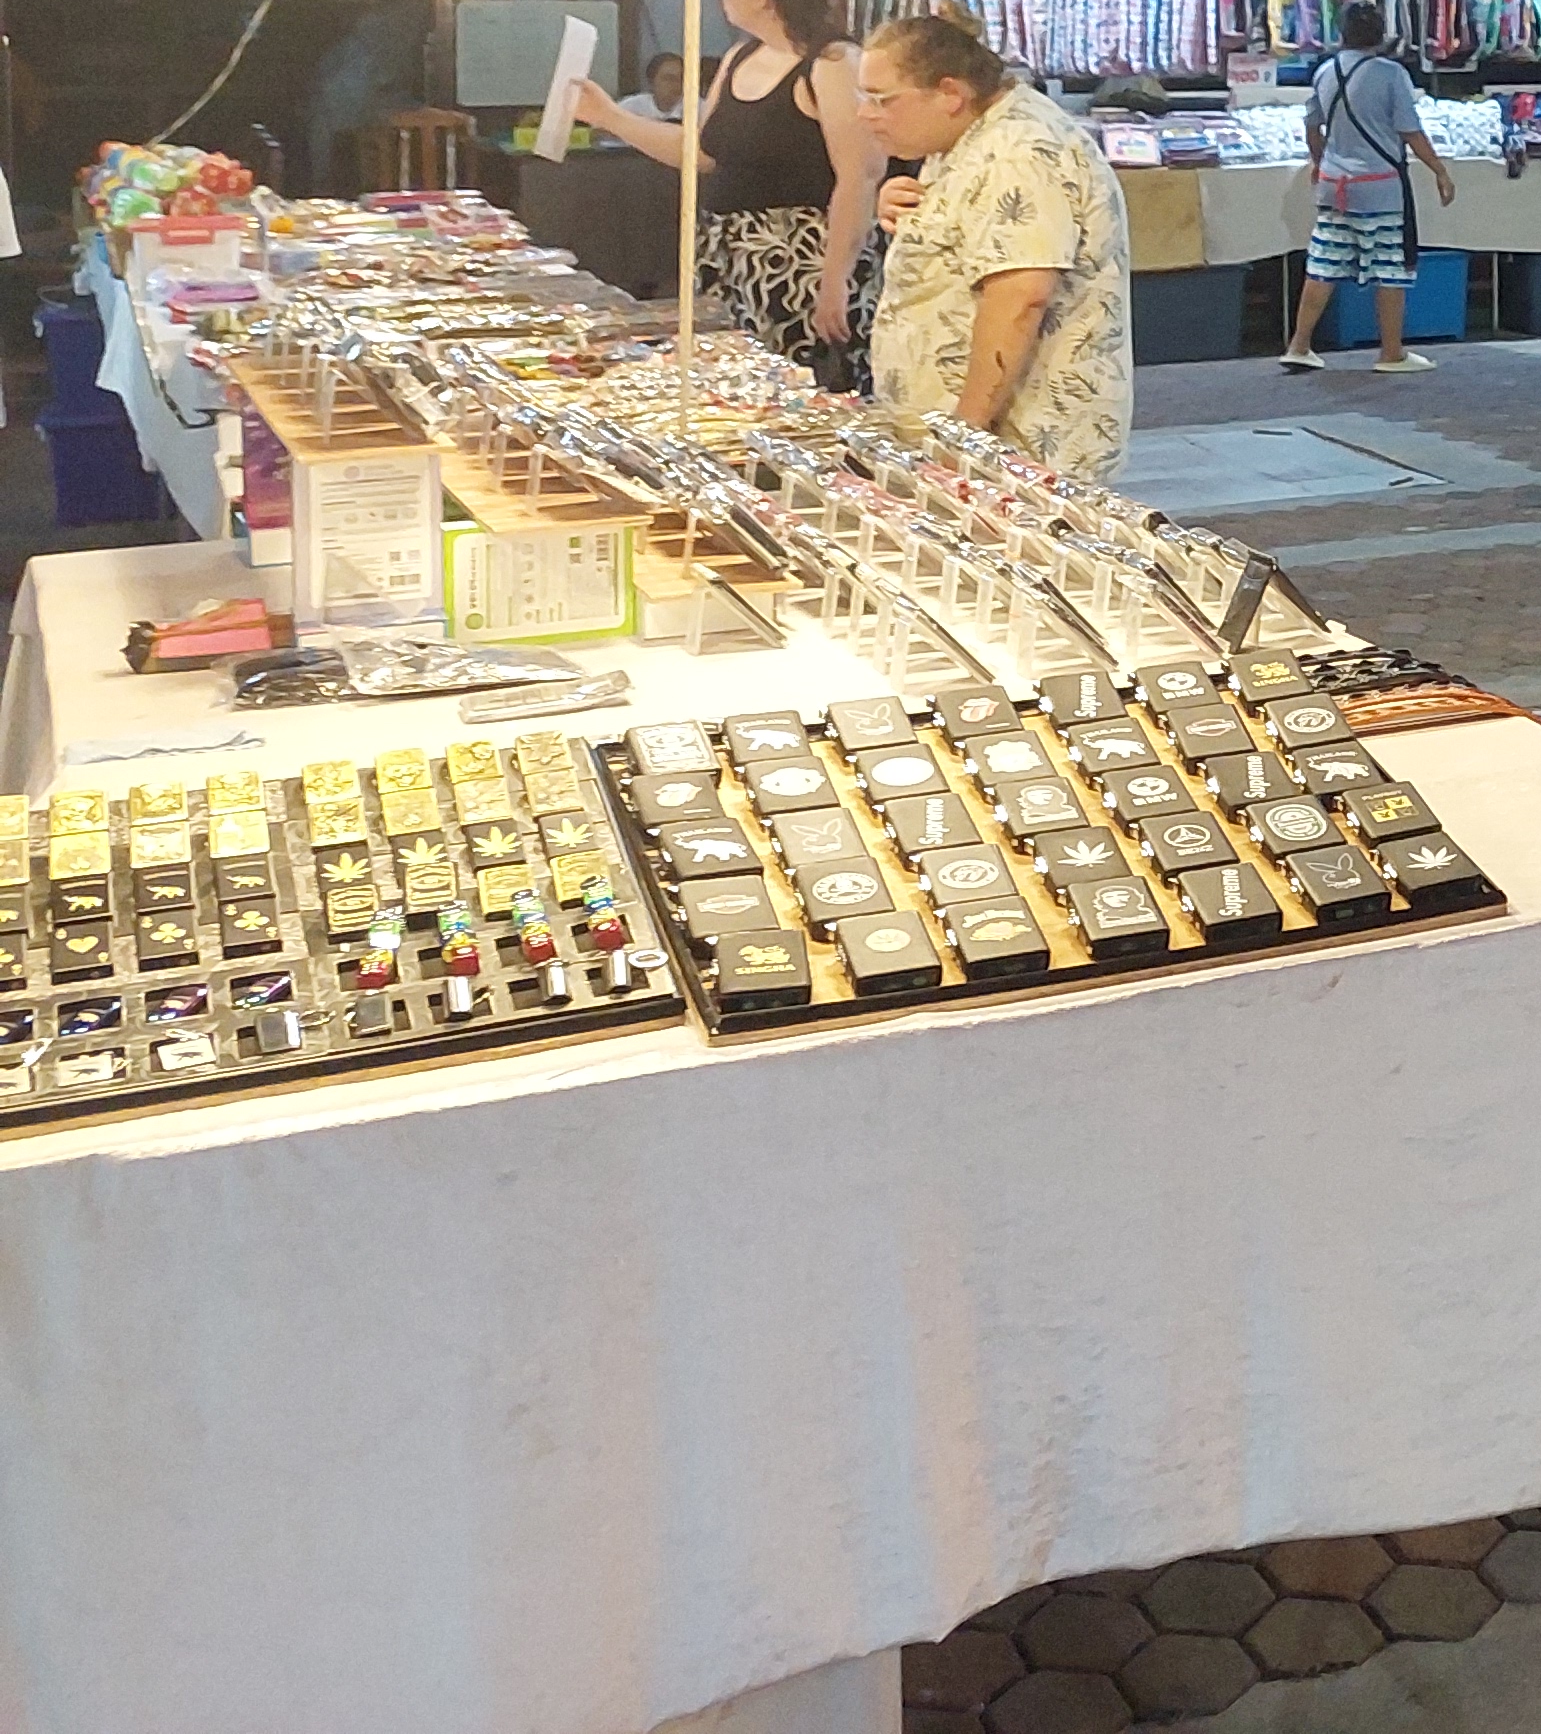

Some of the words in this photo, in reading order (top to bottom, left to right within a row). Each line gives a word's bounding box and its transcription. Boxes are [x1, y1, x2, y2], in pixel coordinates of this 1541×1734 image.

[1073, 674, 1103, 718] Supreme
[1243, 754, 1272, 799] Supreme
[917, 797, 951, 845] Supreme
[1218, 868, 1249, 917] Supreme
